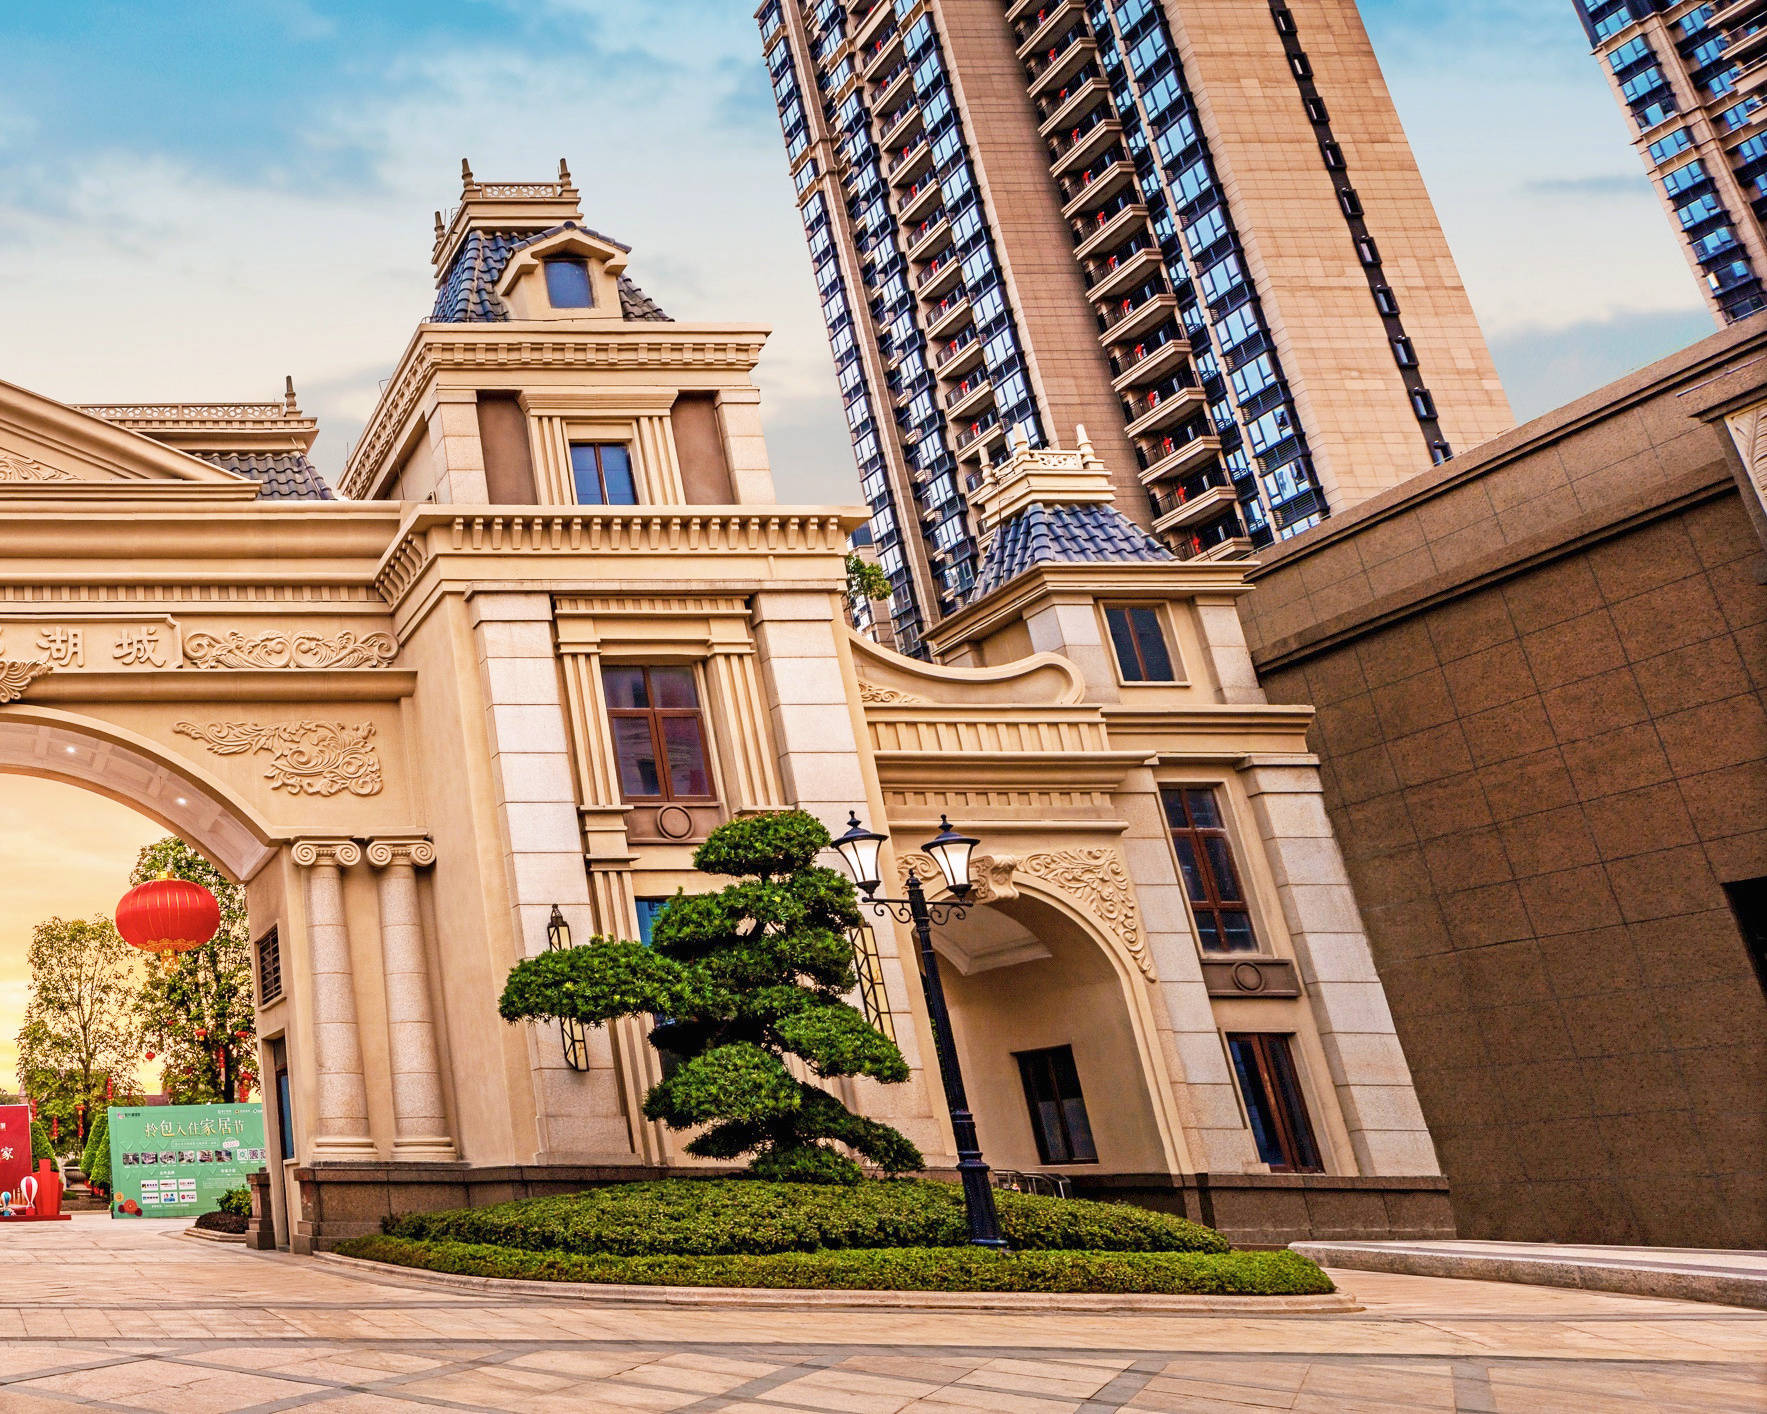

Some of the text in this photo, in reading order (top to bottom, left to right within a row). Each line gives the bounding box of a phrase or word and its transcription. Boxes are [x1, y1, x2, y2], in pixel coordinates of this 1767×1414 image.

[145, 1117, 244, 1137] 拎包入住家居节
